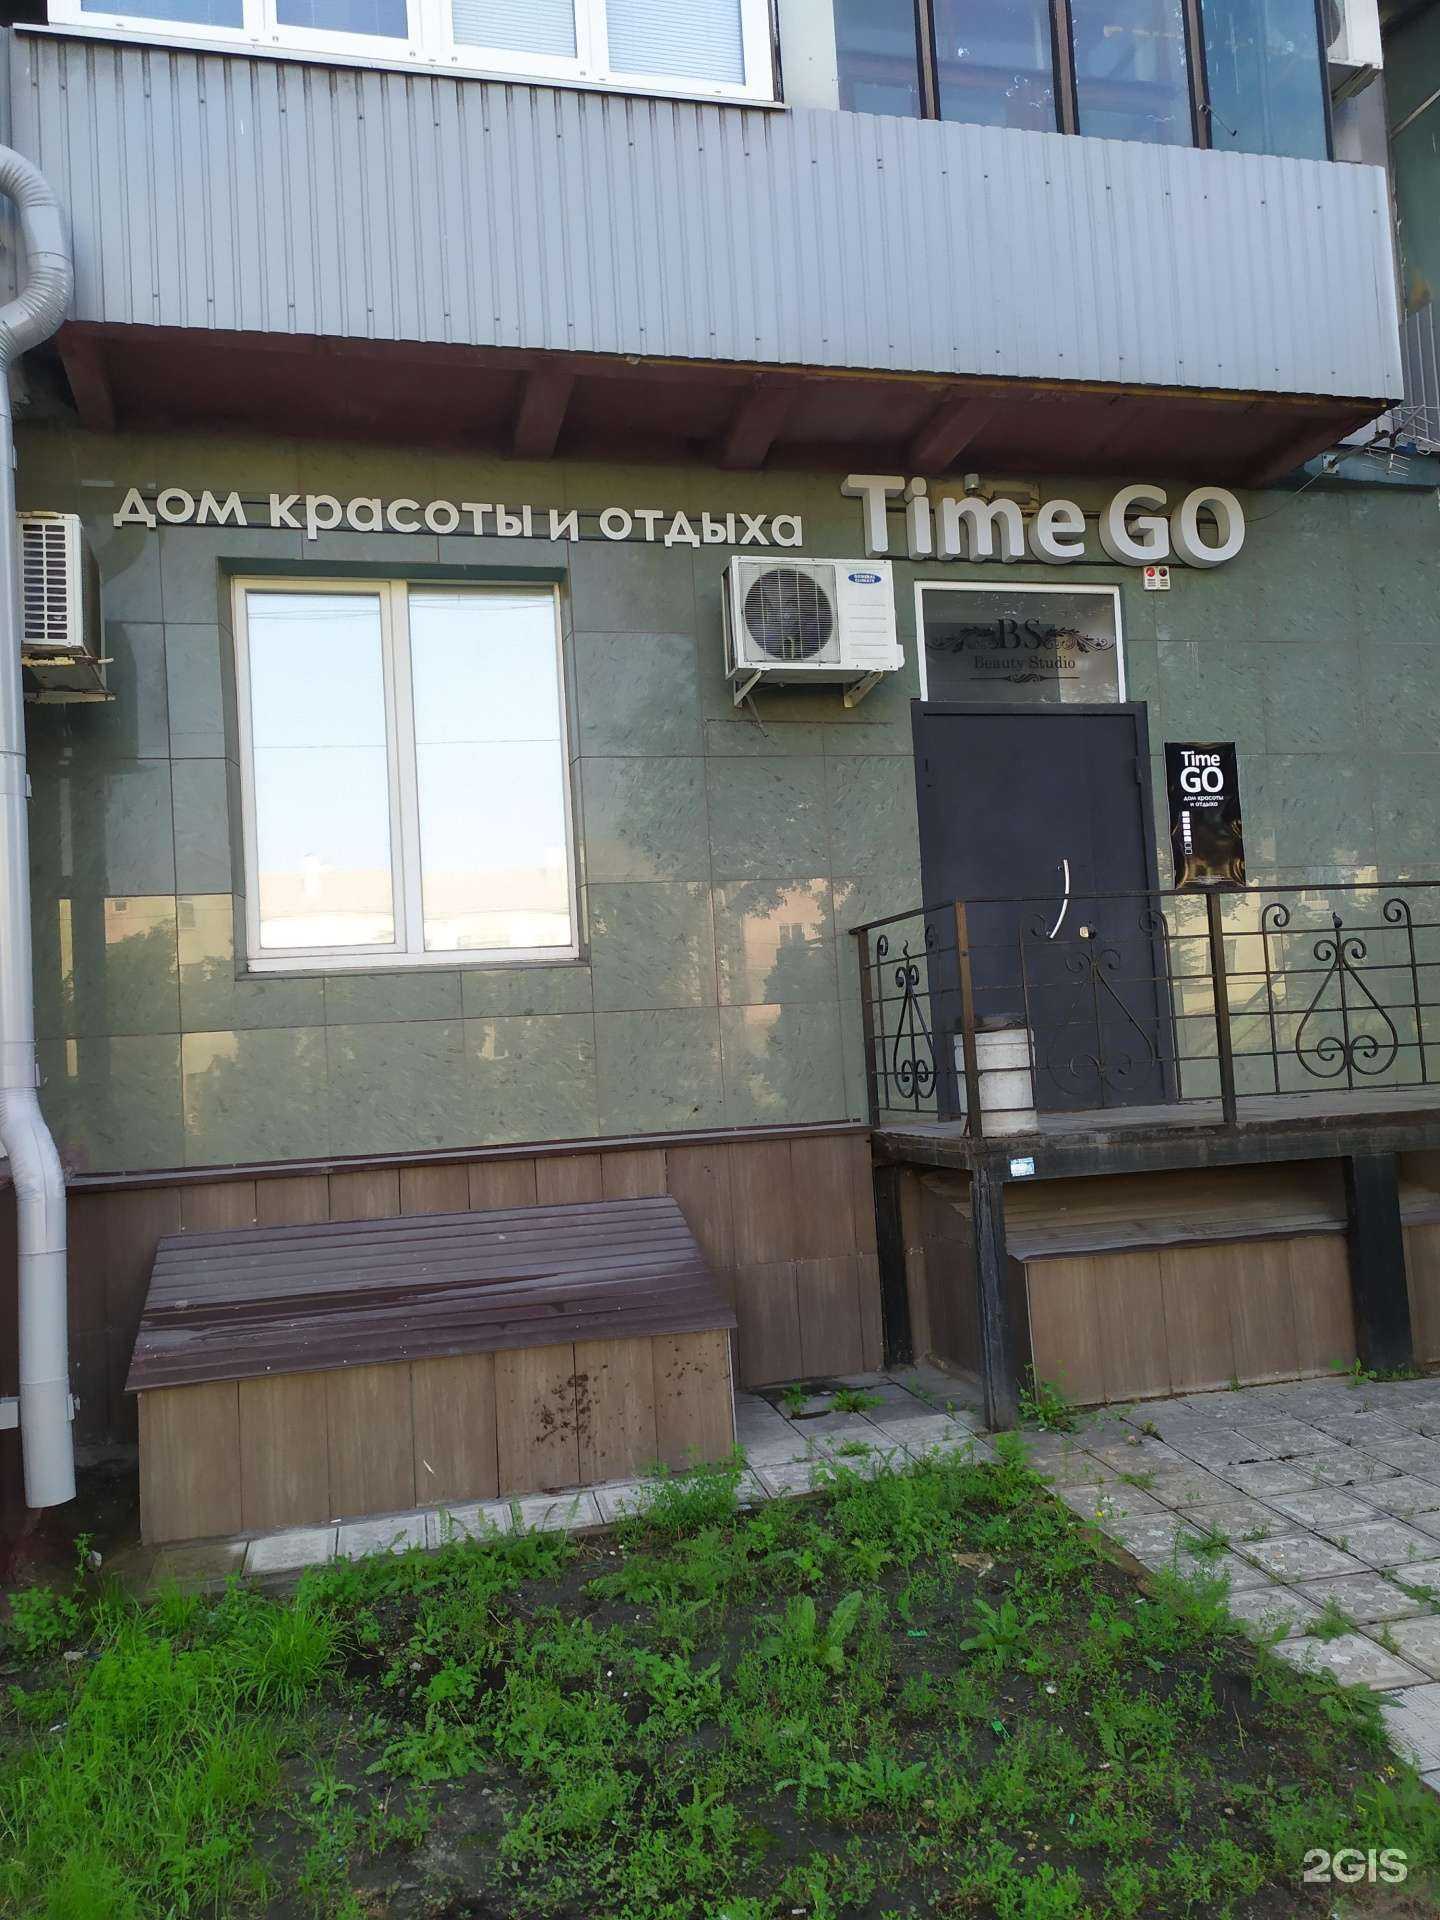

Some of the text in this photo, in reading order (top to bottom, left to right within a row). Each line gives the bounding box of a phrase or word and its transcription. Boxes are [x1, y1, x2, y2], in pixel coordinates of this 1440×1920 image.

[269, 493, 533, 540] красоты
[549, 508, 579, 542] и
[599, 507, 803, 548] отдыха
[840, 474, 1246, 568] Time GO
[974, 655, 1076, 672] Beauty Studio
[1180, 750, 1221, 767] Time
[1180, 766, 1224, 793] GO
